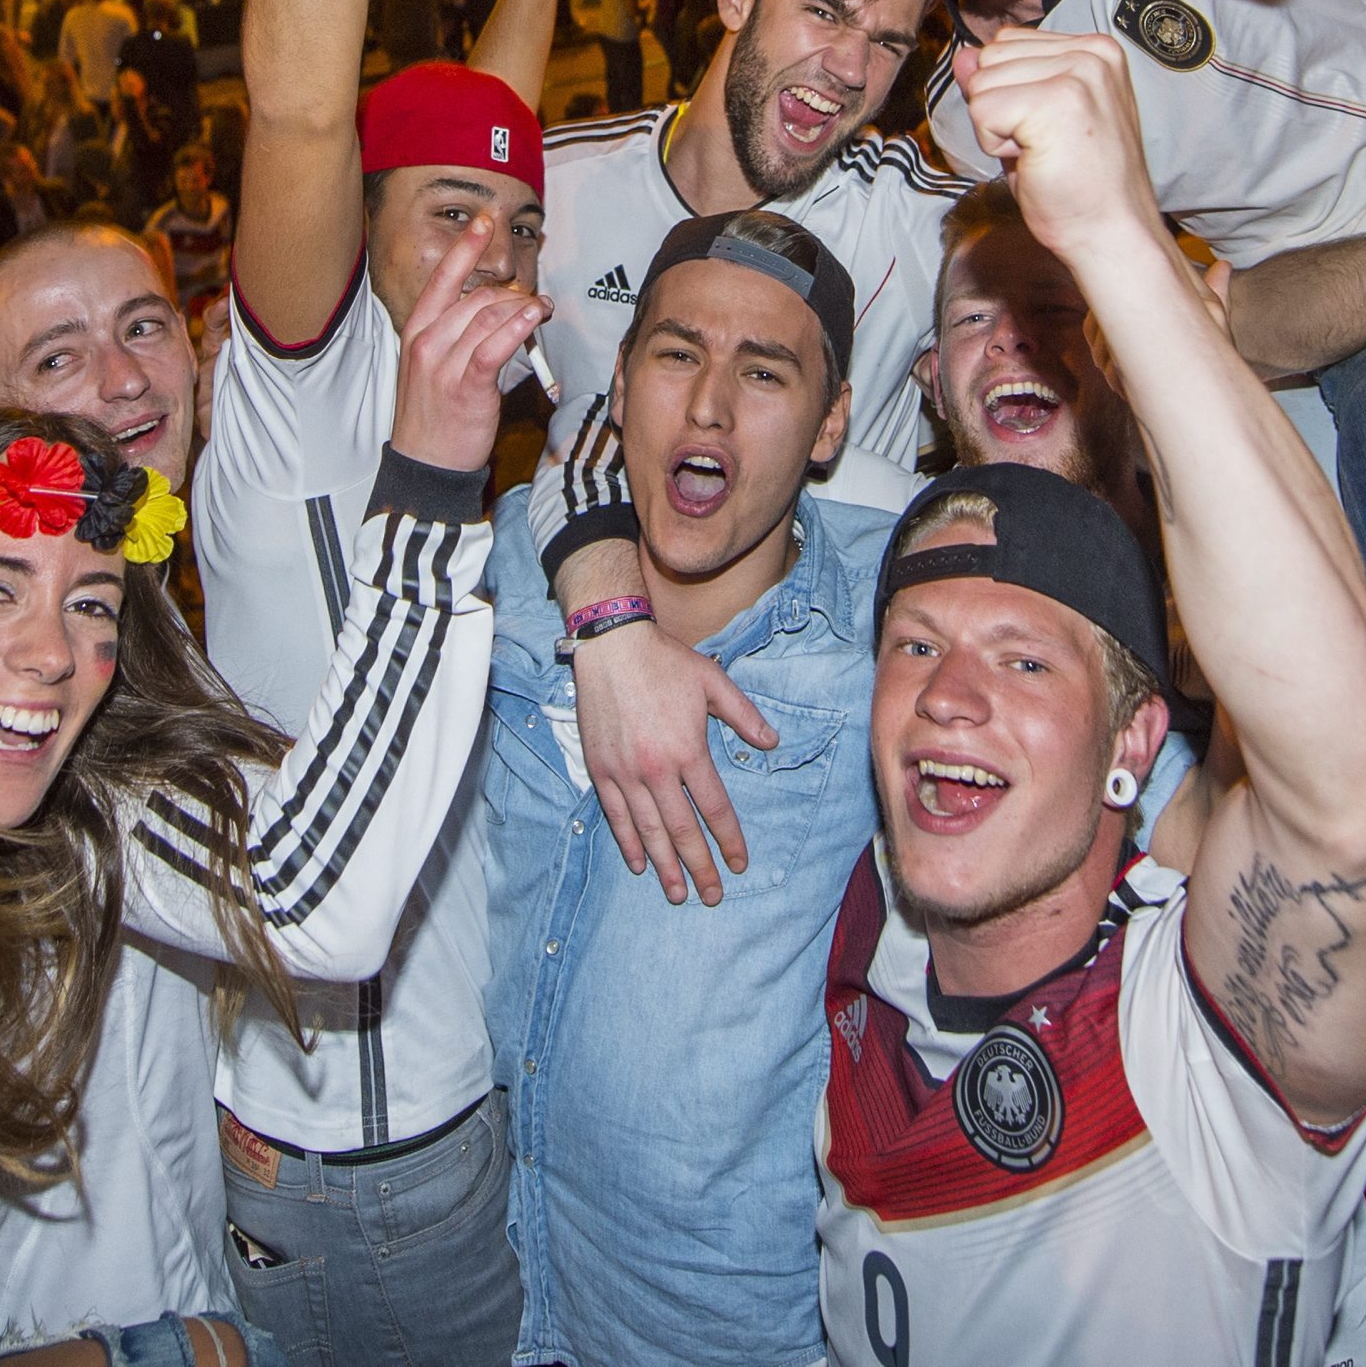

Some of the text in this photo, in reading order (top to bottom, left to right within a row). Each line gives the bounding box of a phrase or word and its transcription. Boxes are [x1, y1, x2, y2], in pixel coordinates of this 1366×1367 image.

[587, 286, 638, 305] adidas
[833, 1010, 862, 1064] adidas
[976, 1043, 1035, 1072] DEUTSCHER
